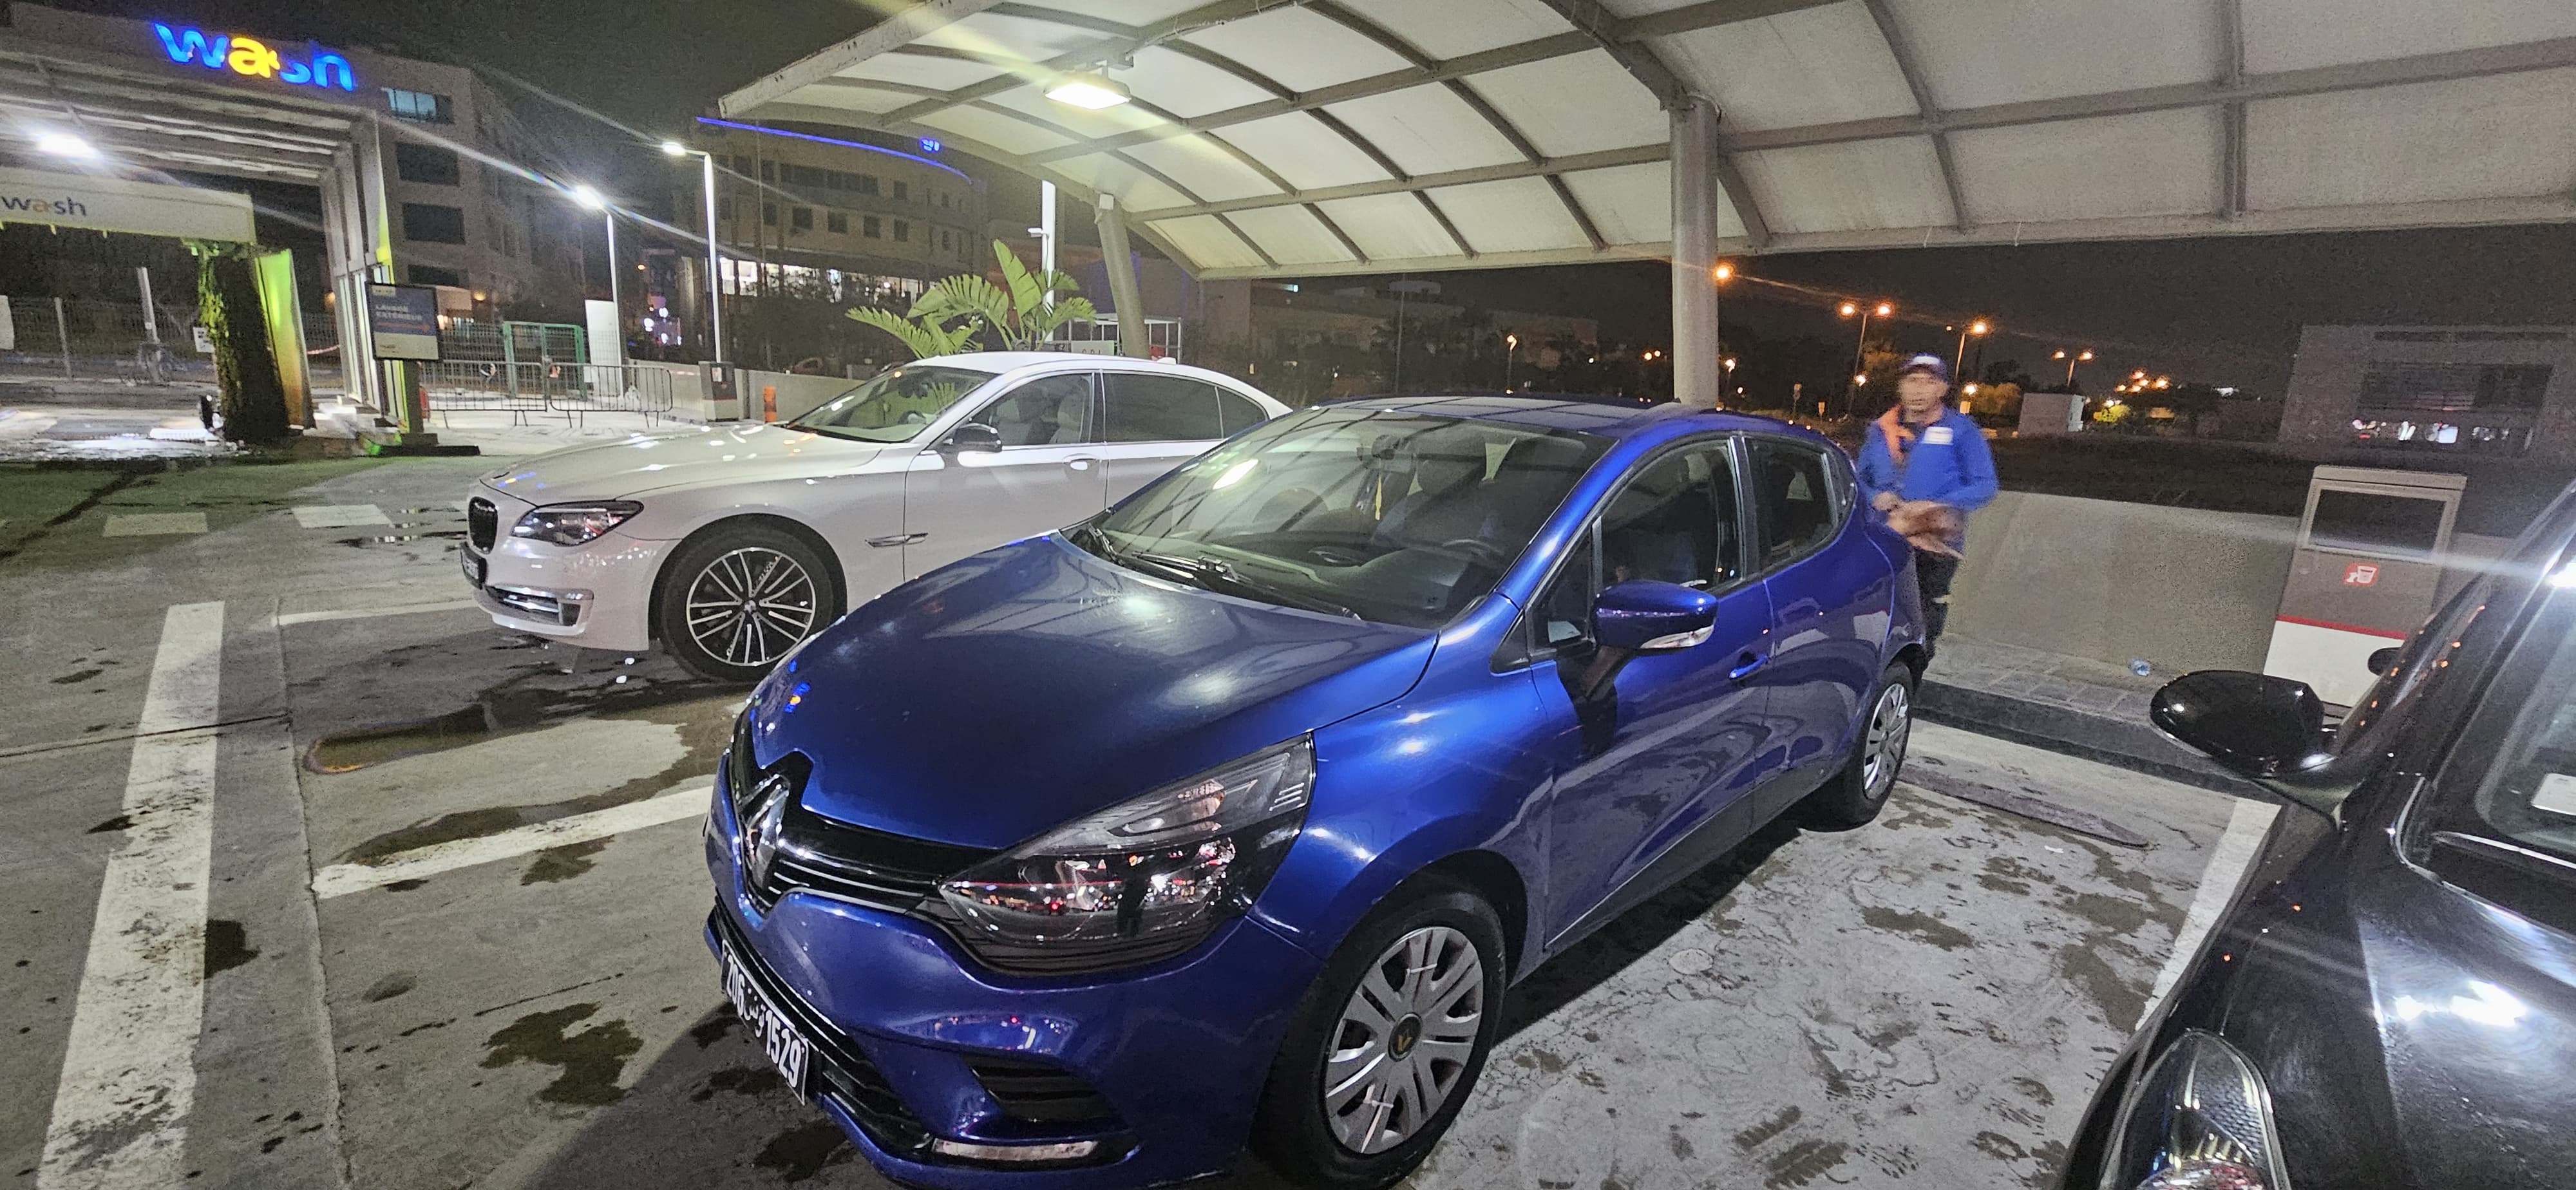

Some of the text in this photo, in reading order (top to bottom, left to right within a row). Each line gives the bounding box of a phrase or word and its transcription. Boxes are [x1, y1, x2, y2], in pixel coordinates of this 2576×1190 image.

[1, 195, 86, 216] wash
[726, 954, 802, 1088] 206 تونس 1529
